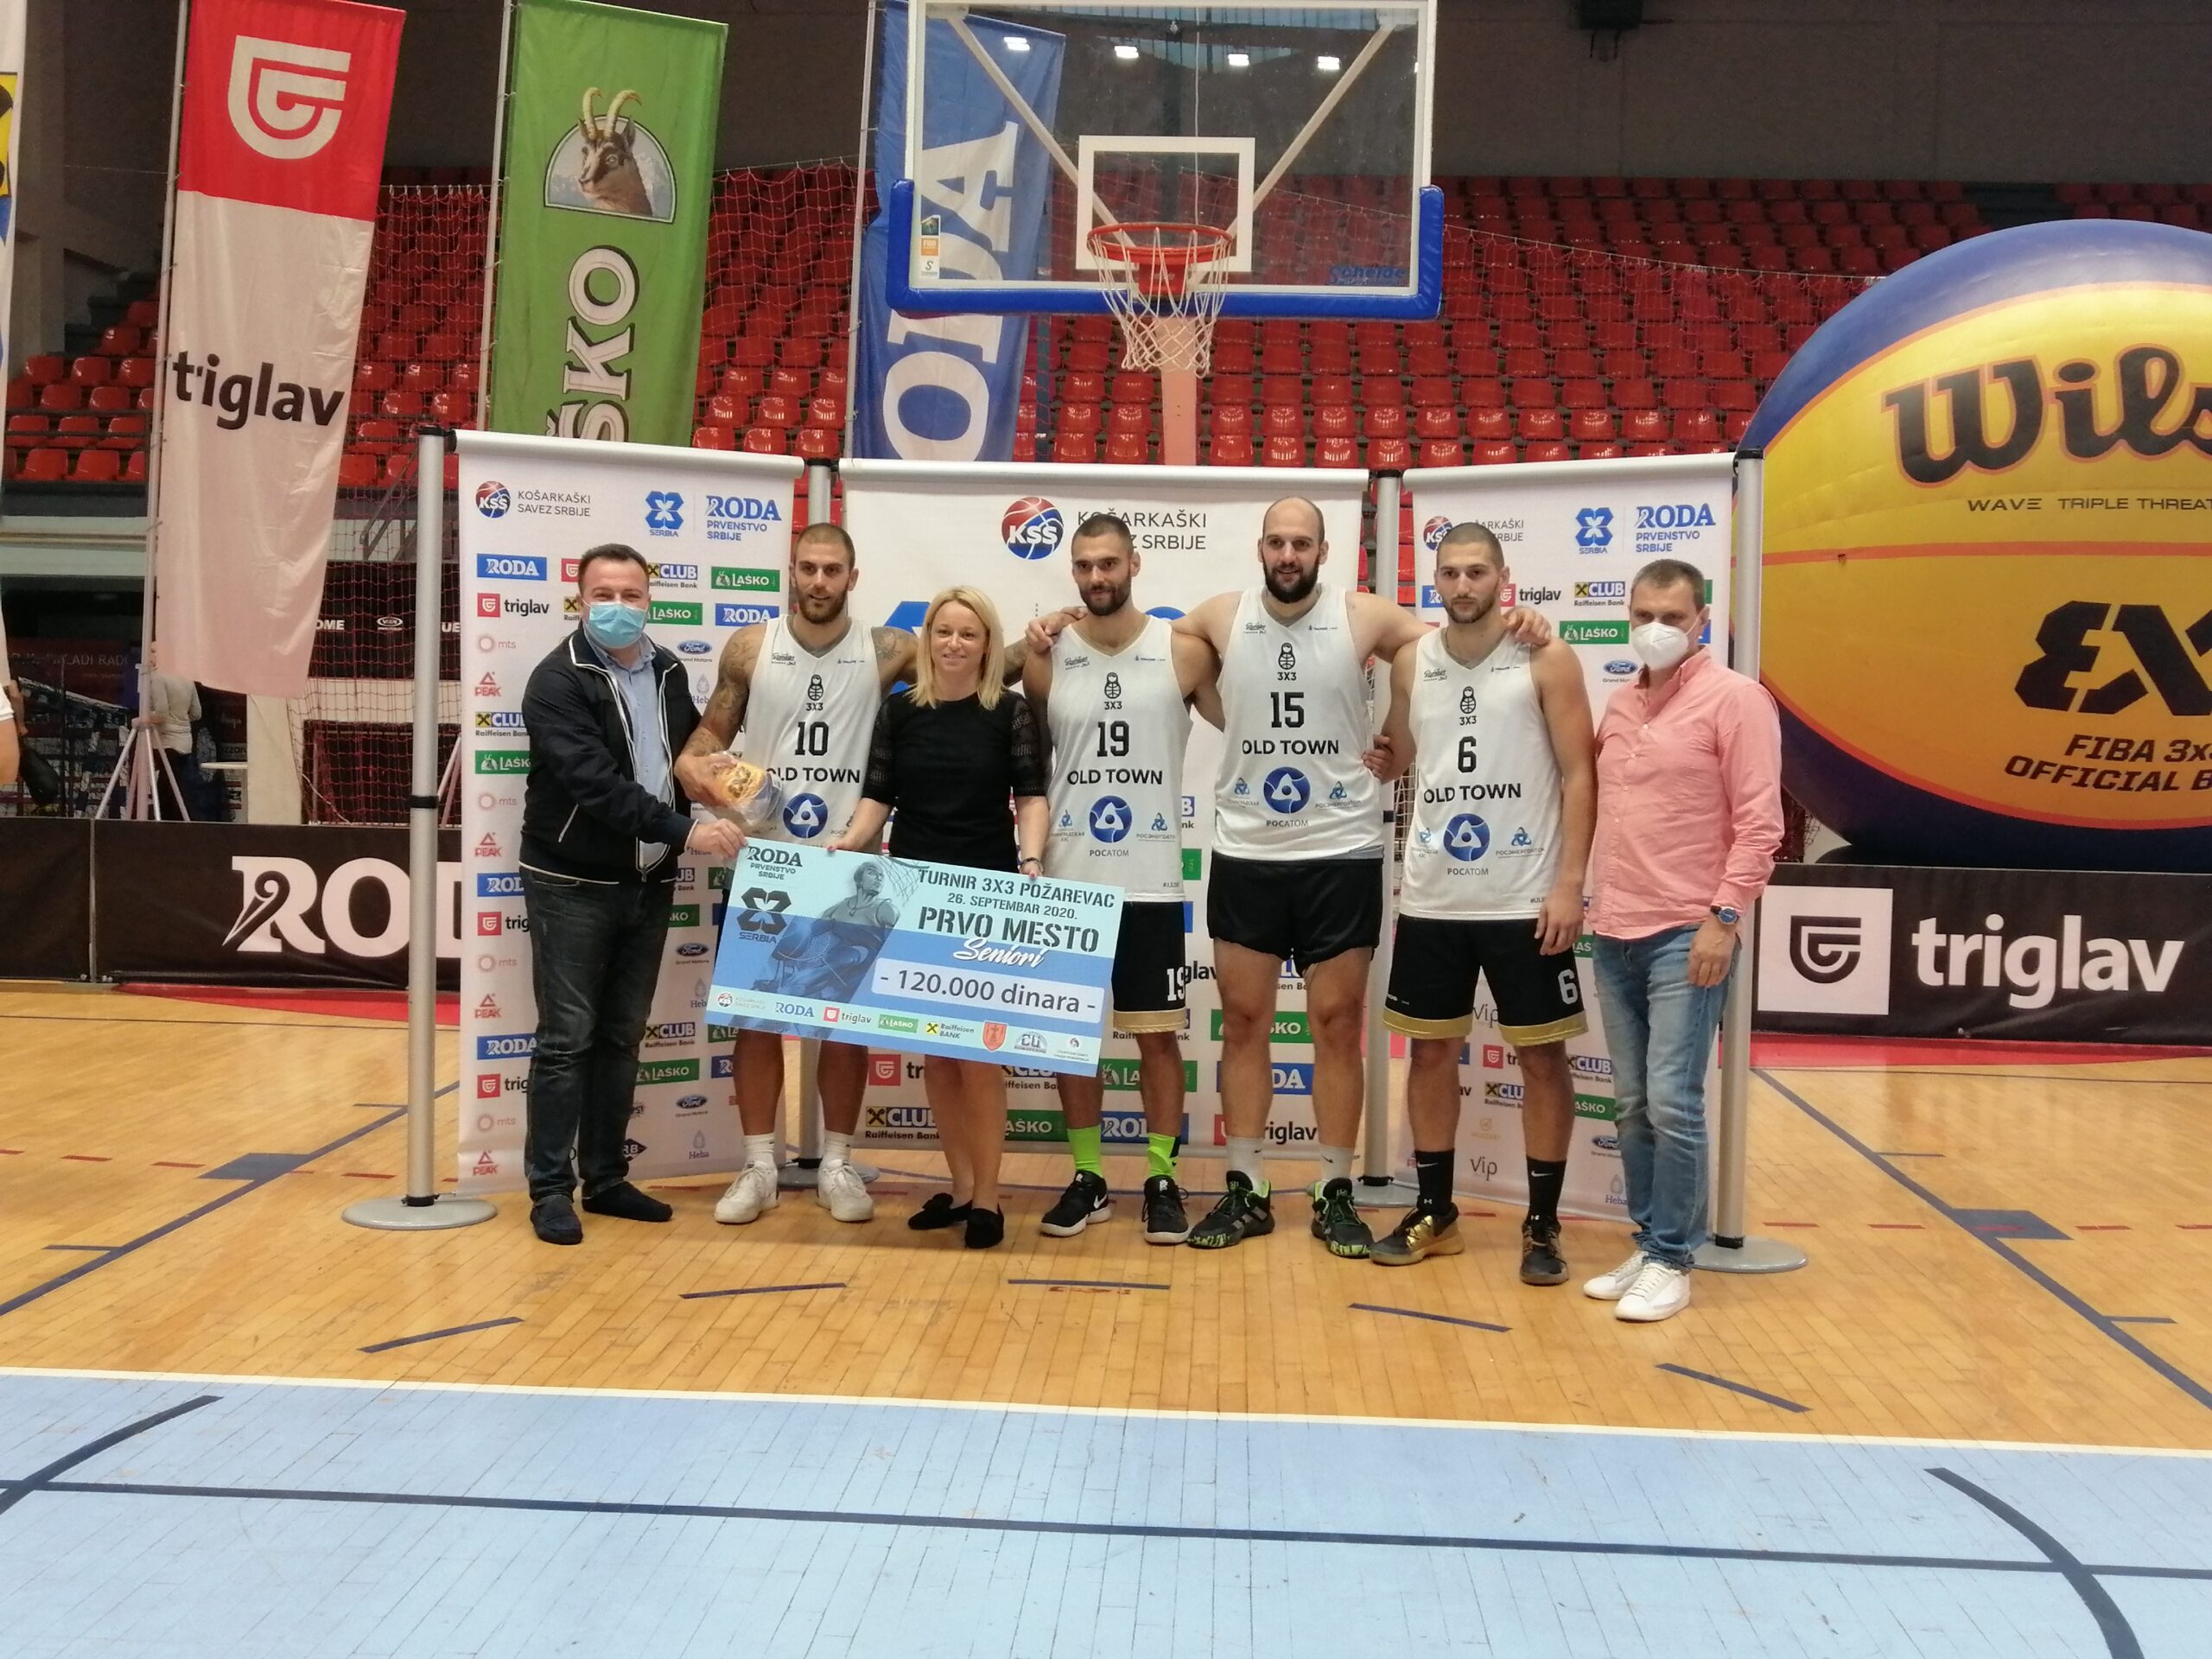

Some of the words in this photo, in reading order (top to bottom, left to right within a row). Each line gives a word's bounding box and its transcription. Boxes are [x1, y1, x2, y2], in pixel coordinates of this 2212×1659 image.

[173, 350, 346, 431] triglav
[480, 496, 508, 512] KSS
[518, 489, 591, 504] KOŠARKAŠKI
[518, 503, 552, 515] SAVEZ
[555, 505, 591, 517] SRBIJE
[706, 495, 782, 521] RODA
[1967, 498, 2043, 512] WAVE
[2058, 498, 2129, 510] TRIPLE
[2137, 498, 2212, 511] THREAT
[1635, 503, 1716, 529] RODA
[650, 529, 679, 537] SERBIA
[707, 520, 767, 532] PRVENSTVO
[707, 531, 742, 541] SRBIJE
[1008, 525, 1058, 545] KSS
[1141, 534, 1207, 550] SRBIJE
[1636, 531, 1700, 542] PRVENSTVO
[1636, 543, 1673, 553] SRBIJE
[486, 558, 540, 576] RODA
[732, 573, 770, 588] LAŠKO
[1519, 587, 1562, 605] triglav
[504, 599, 550, 617] triglav
[652, 606, 692, 620] LAŠKO
[723, 607, 772, 623] RODA
[1580, 626, 1618, 641] LAŠKO
[498, 640, 517, 649] mts
[1277, 671, 1297, 681] 3X3
[805, 702, 823, 711] 3X3
[1103, 701, 1122, 710] 3X3
[1270, 691, 1305, 728] 15
[1459, 715, 1478, 726] 3X3
[794, 721, 830, 756] 10
[1096, 720, 1130, 758] 19
[1242, 740, 1275, 754] OLD
[1281, 740, 1339, 755] TOWN
[1458, 735, 1477, 773] 6
[2064, 734, 2156, 763] FIBA
[803, 766, 861, 784] TOWN
[1067, 769, 1102, 785] OLD
[1106, 768, 1163, 785] TOWN
[2004, 754, 2180, 792] OFFICIAL
[1423, 787, 1456, 804] OLD
[1459, 783, 1522, 801] TOWN
[747, 845, 804, 868] RODA
[750, 862, 797, 874] PRVENSTVO
[758, 870, 785, 880] SRBIJE
[918, 868, 977, 890] TURNIR
[982, 877, 1014, 895] 3X3
[1020, 882, 1116, 908] POŽAREVAC
[947, 893, 966, 906] 26.
[969, 895, 1040, 915] SEPTEMBAR
[1043, 906, 1078, 920] 2020.
[918, 906, 994, 938] PRVO
[1001, 917, 1100, 953] MESTO
[739, 932, 777, 944] SERBIA
[953, 938, 1050, 969] Seniori
[1911, 913, 2185, 1009] triglav
[899, 969, 995, 1001] 120.000
[1001, 983, 1080, 1013] dinara
[1166, 966, 1185, 1001] 19
[1558, 969, 1579, 1005] 6
[775, 1001, 815, 1018] RODA
[841, 1012, 872, 1024] triglav
[940, 1022, 975, 1033] Raiffeisen
[1005, 1118, 1052, 1134] AŠKO
[865, 1130, 914, 1140] Raiffeisen
[1470, 1156, 1498, 1181] Vip
